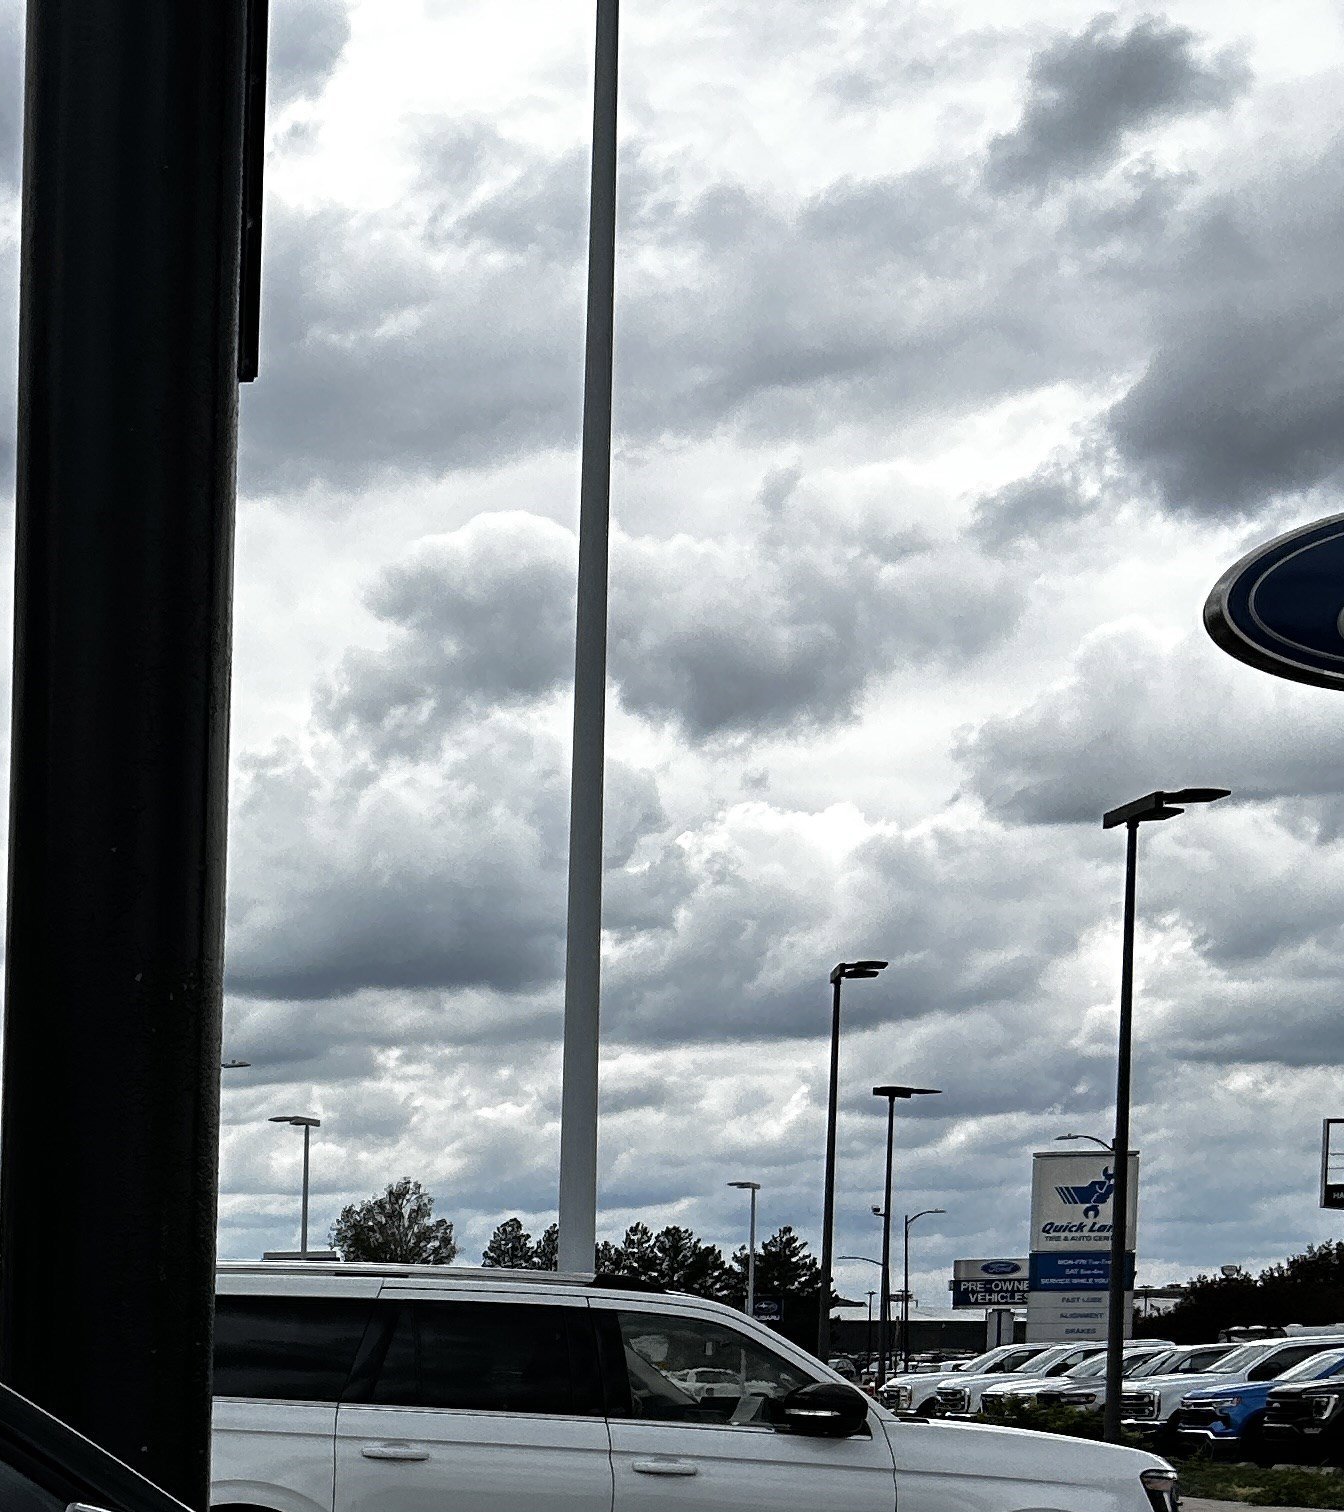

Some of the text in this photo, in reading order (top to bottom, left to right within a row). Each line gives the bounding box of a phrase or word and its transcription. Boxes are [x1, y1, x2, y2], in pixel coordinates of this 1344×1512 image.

[1042, 1221, 1113, 1234] Quick La
[960, 1280, 1029, 1291] PRE-OWNE
[968, 1292, 1029, 1303] VEHICLES
